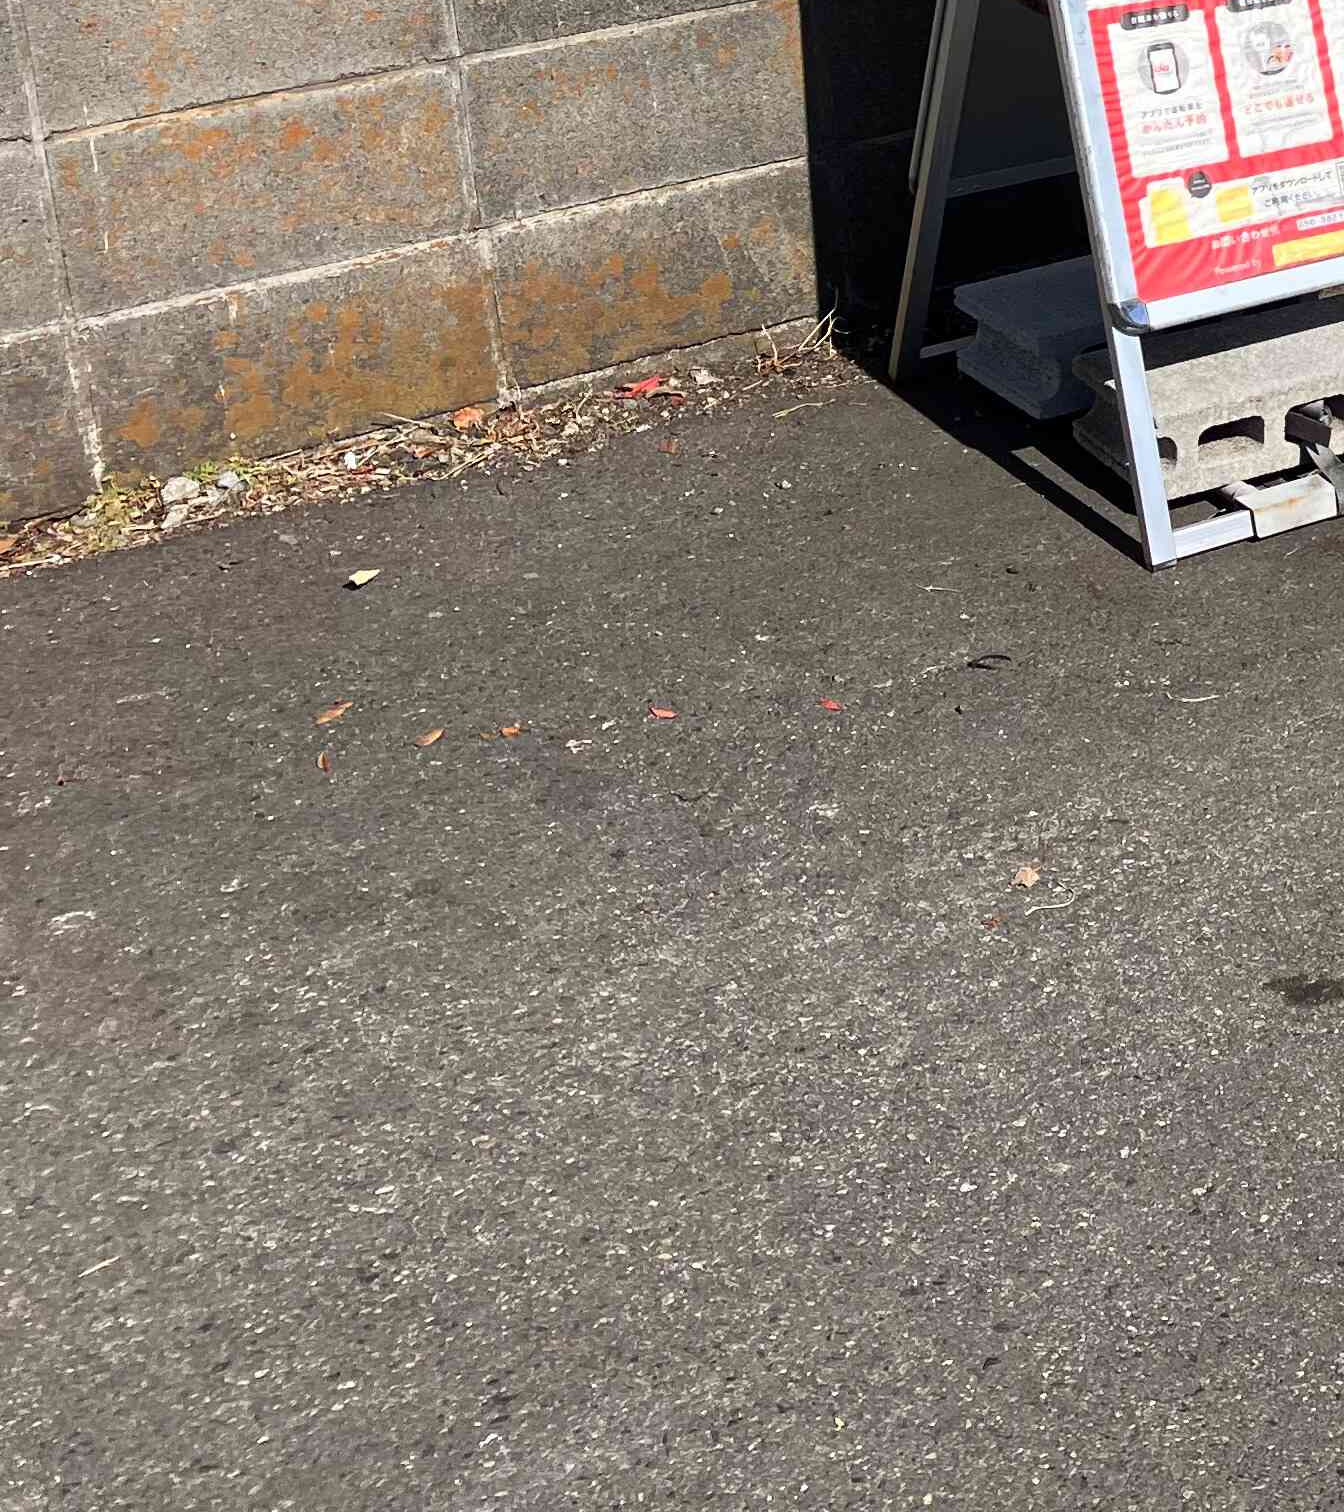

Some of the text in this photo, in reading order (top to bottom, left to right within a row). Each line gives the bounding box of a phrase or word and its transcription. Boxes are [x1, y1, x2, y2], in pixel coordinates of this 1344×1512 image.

[1251, 170, 1333, 194] アプリをダウンロードして
